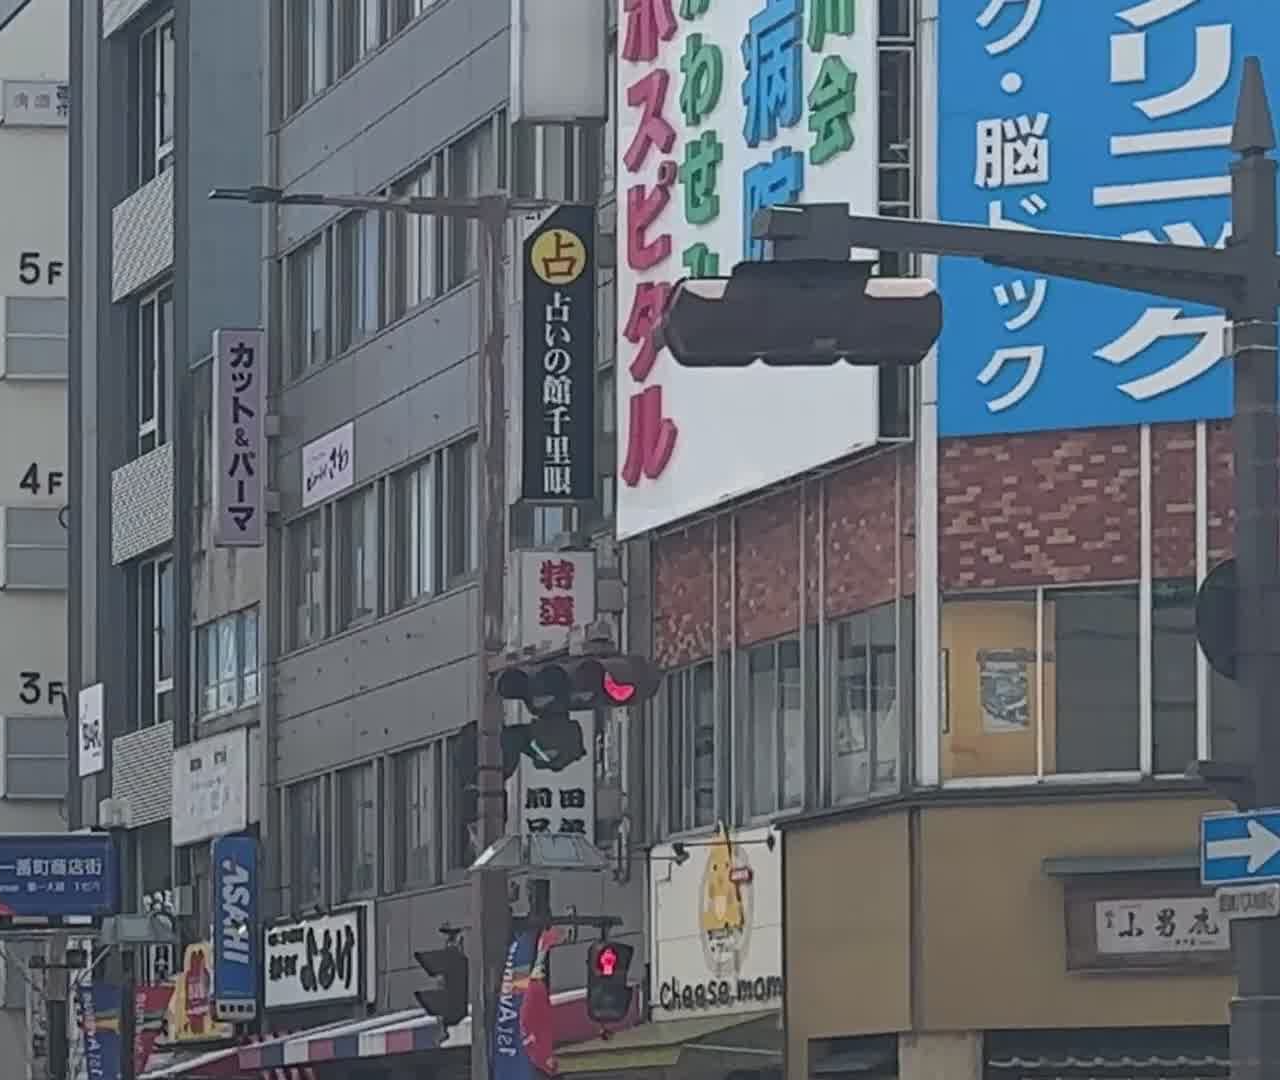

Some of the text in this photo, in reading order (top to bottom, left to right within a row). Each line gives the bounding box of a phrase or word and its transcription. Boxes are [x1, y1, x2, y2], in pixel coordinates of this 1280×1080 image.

[1092, 0, 1235, 401] リニク
[19, 252, 64, 285] 5F
[541, 231, 578, 279] 占
[542, 291, 573, 495] 占いの館千里眼
[227, 341, 256, 531] カット&パーマ
[19, 462, 64, 495] 4F
[19, 672, 64, 705] 3F
